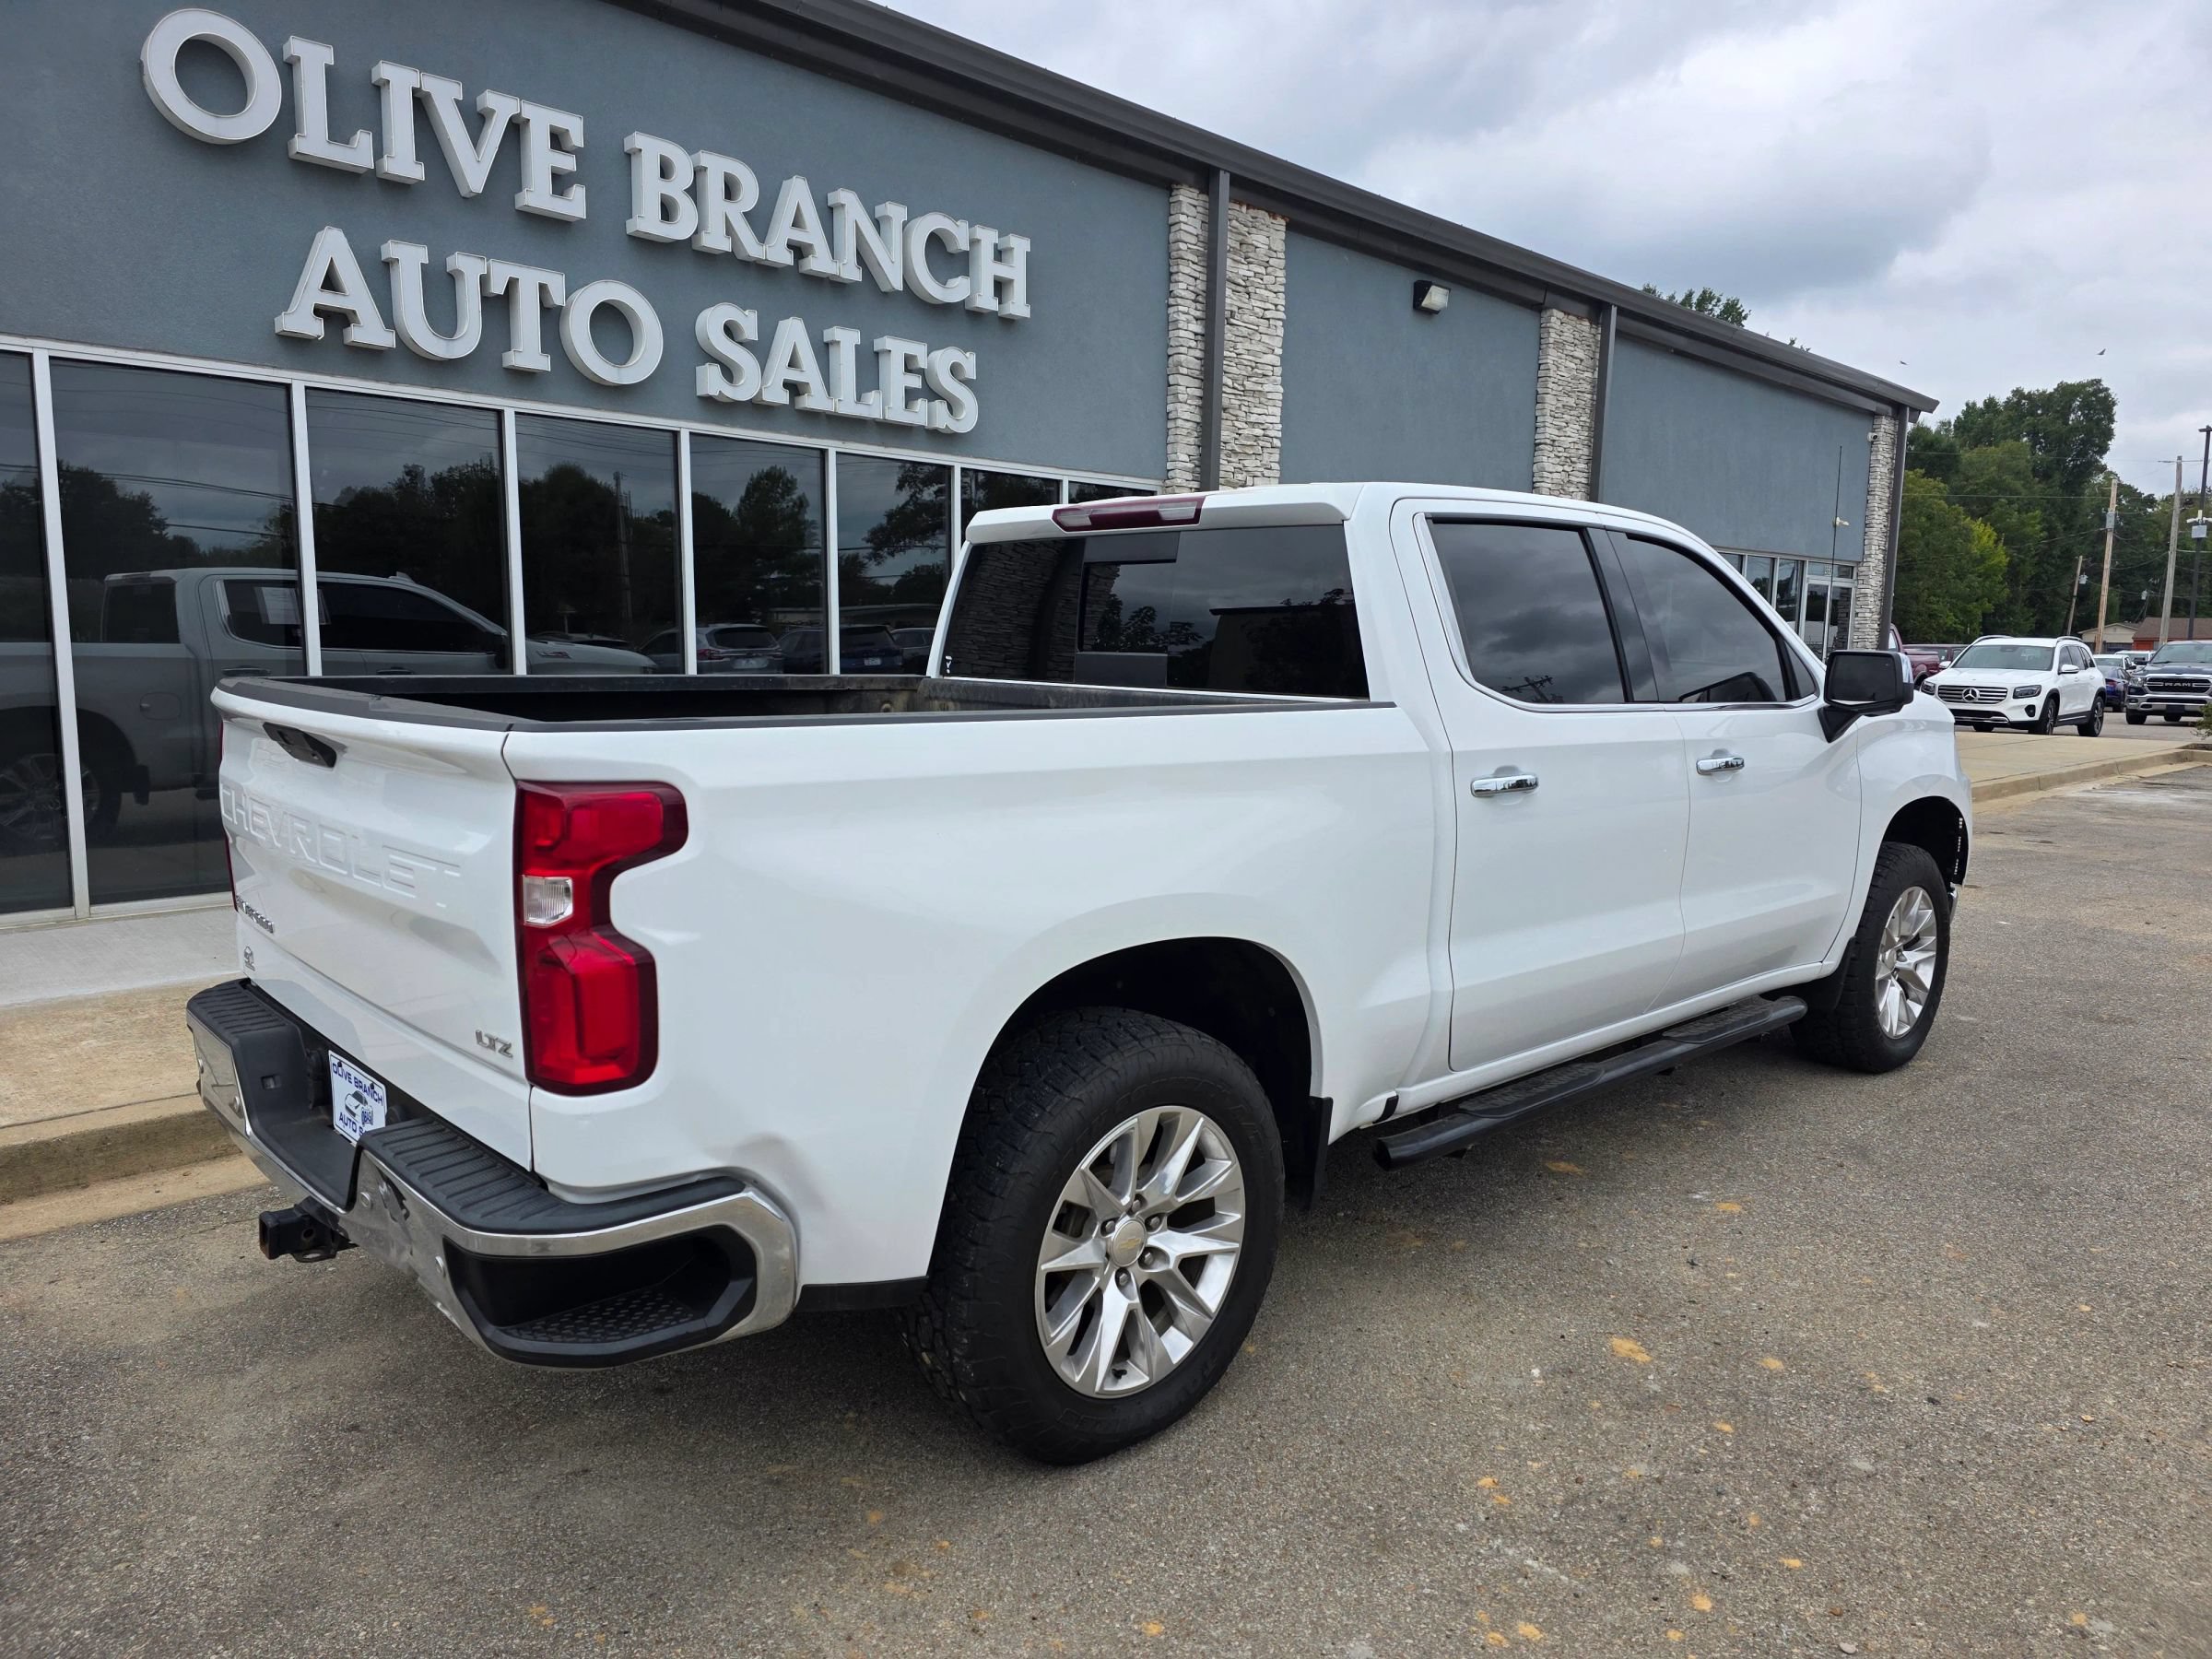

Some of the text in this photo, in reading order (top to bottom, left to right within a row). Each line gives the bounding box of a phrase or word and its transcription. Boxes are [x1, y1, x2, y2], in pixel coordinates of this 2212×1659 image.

[139, 7, 1031, 321] OLIVE BRANCH
[275, 226, 979, 434] AUTO SALES
[220, 782, 461, 908] CHEVROLET
[332, 1062, 383, 1107] OLIVE BRANCH
[475, 1029, 513, 1058] LTZ
[338, 1112, 358, 1134] AUTO
